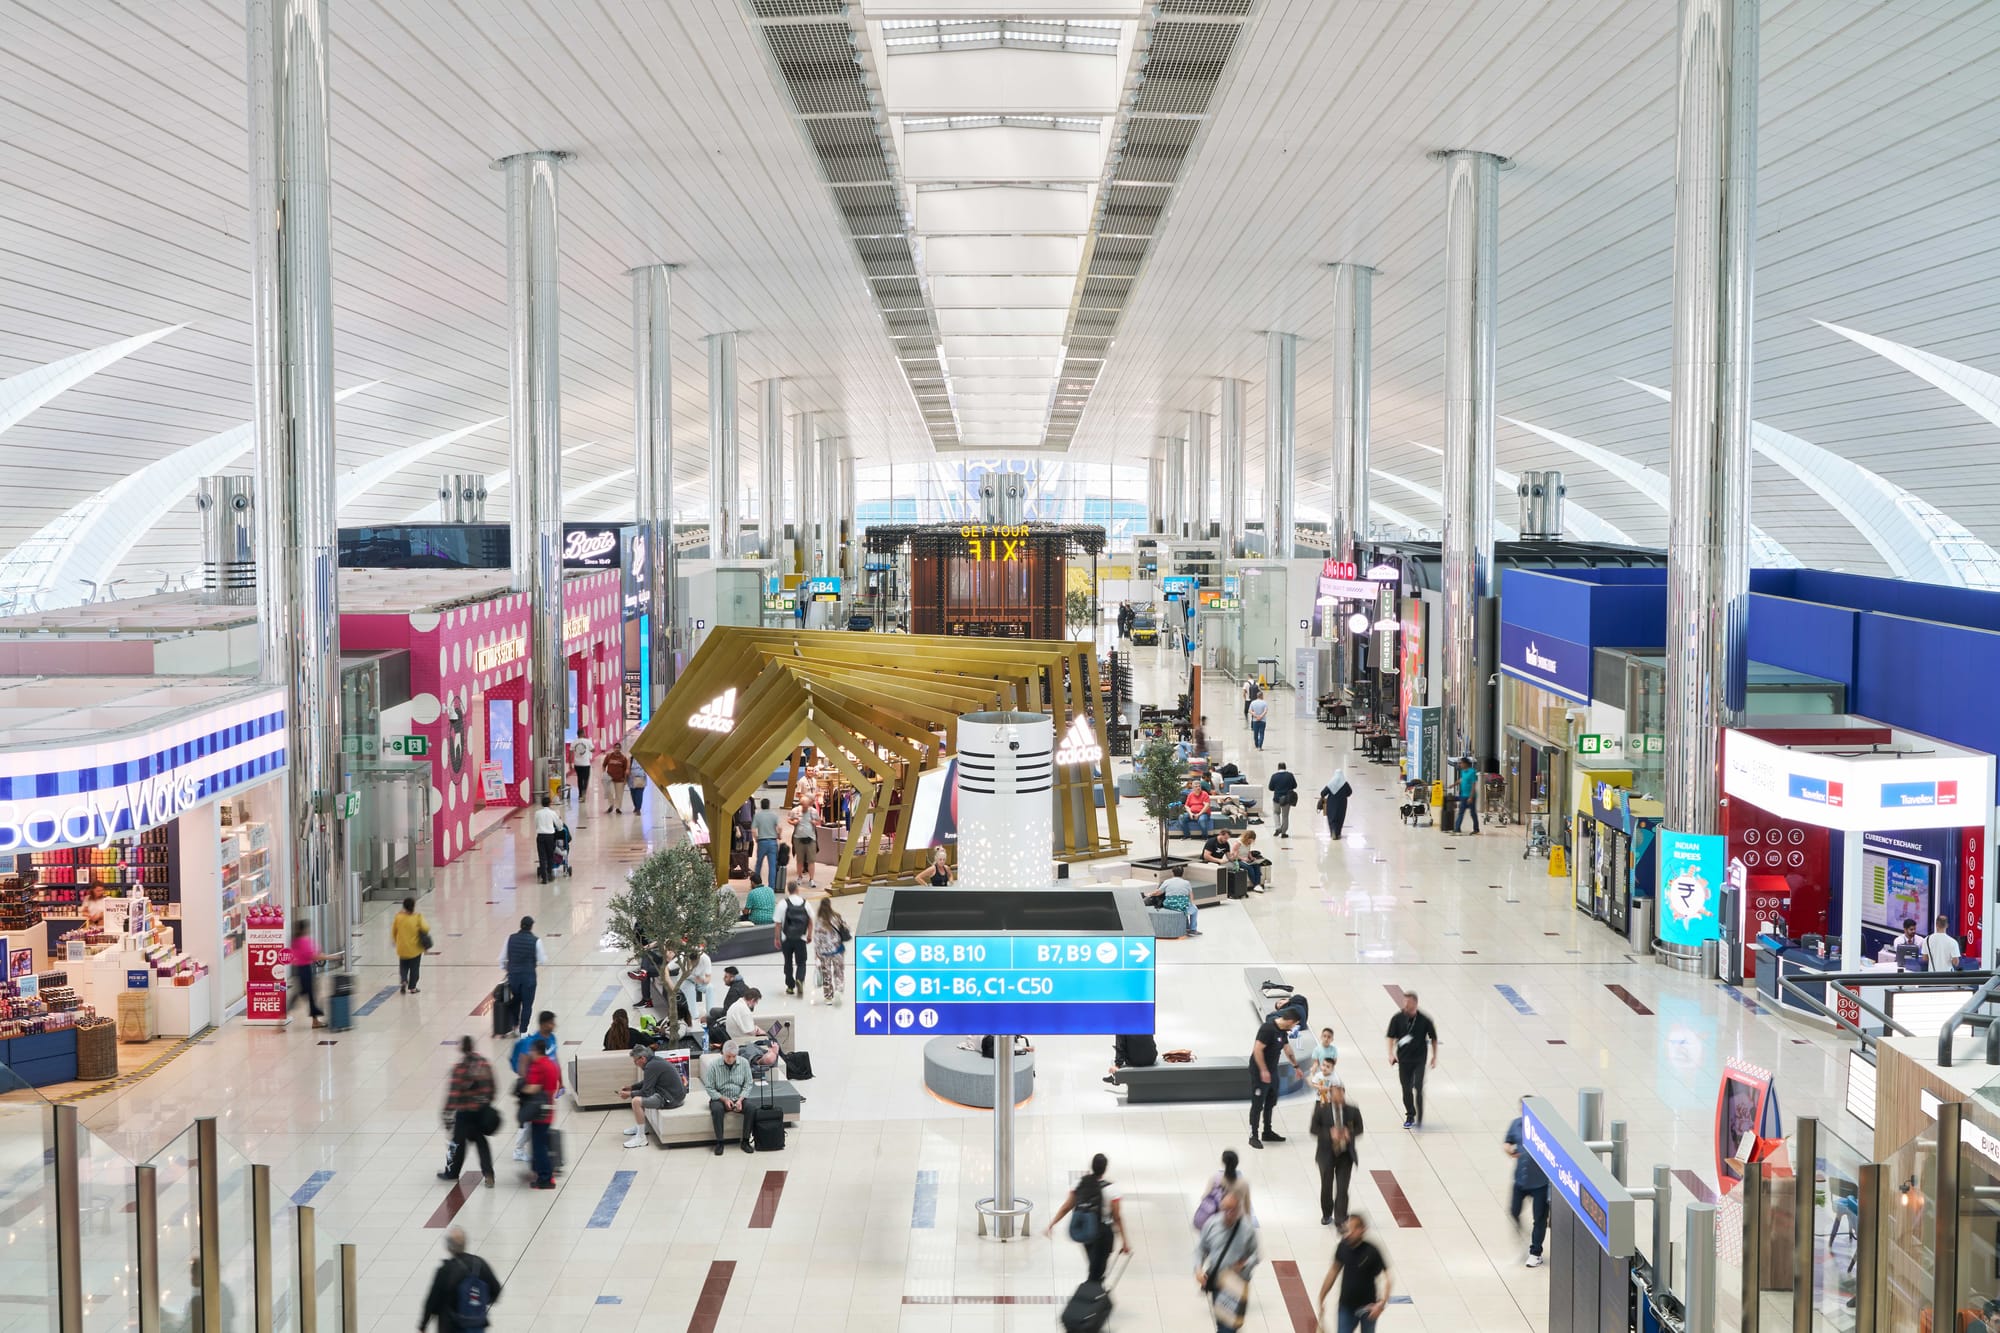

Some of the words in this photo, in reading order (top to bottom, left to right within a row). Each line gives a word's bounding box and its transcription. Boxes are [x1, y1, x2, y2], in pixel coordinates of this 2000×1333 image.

[961, 525, 987, 537] GET
[992, 525, 1029, 537] YOUR
[562, 530, 616, 560] Boots
[819, 581, 833, 592] B4
[687, 713, 735, 733] adidas
[1056, 744, 1103, 766] adidas
[1900, 793, 1934, 805] Travelex
[0, 790, 121, 851] Body
[126, 768, 197, 830] Works
[1675, 841, 1700, 850] INDIAN
[1865, 833, 1893, 845] CURRENCY
[1893, 839, 1922, 851] EXCHANGE
[1673, 851, 1701, 860] RUPEES
[254, 950, 278, 966] 19
[920, 944, 950, 964] B8,
[953, 944, 986, 962] B10
[1037, 944, 1063, 964] B7,
[1067, 944, 1091, 962] B9
[253, 1002, 280, 1012] FREE
[1531, 1125, 1556, 1168] Departures
